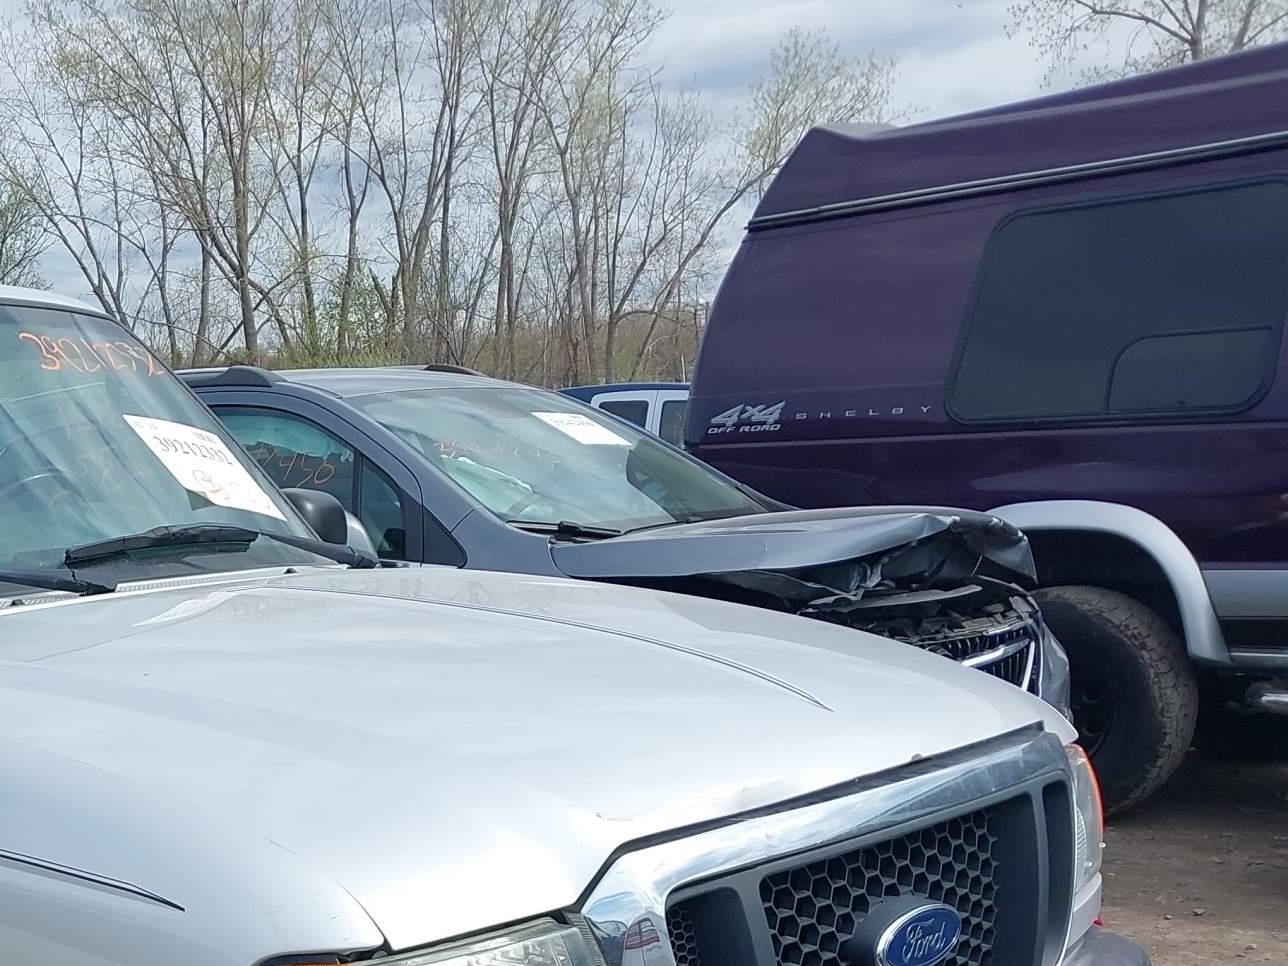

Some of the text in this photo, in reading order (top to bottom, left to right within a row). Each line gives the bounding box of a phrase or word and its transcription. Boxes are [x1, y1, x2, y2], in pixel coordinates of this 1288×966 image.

[795, 405, 932, 420] SHELBY
[707, 423, 782, 435] OFF ROAD
[152, 435, 234, 466] 39212332
[902, 917, 948, 963] Ford
